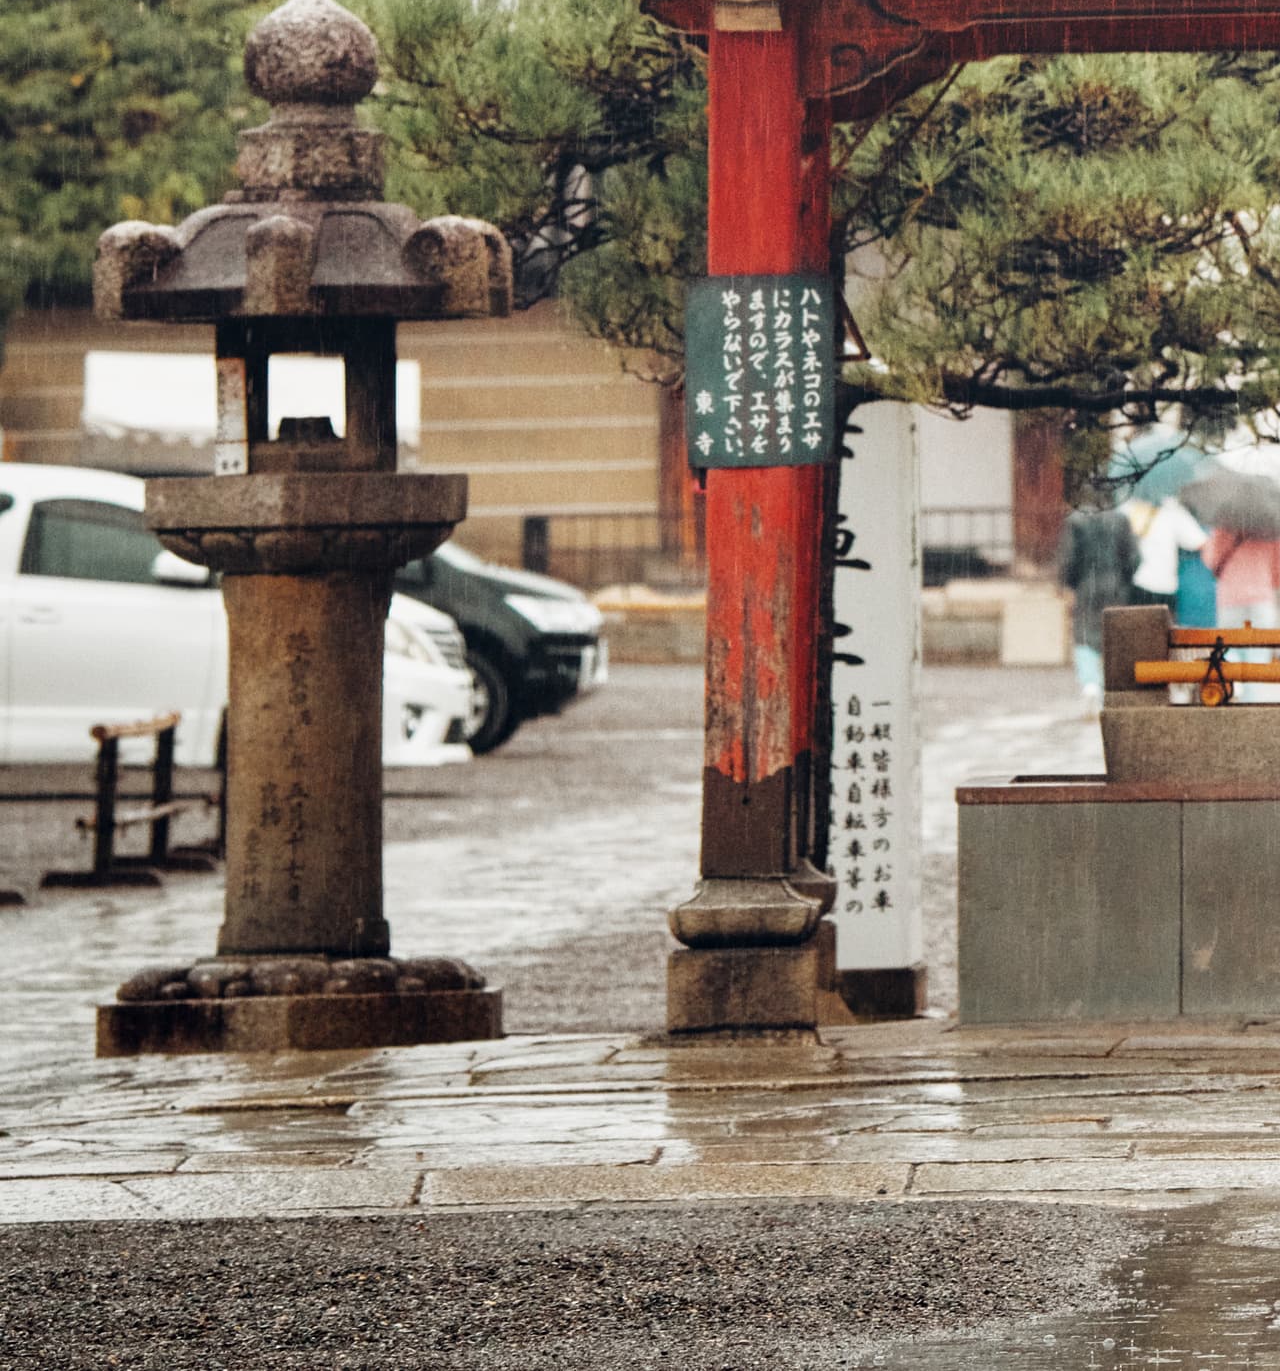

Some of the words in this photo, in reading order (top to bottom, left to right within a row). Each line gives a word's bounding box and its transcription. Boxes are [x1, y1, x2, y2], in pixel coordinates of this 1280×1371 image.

[694, 389, 715, 456] 東寺
[721, 289, 745, 458] やらないで下さい。
[773, 289, 795, 453] にカラスが集まり
[800, 288, 822, 450] ハトやネコのエサ
